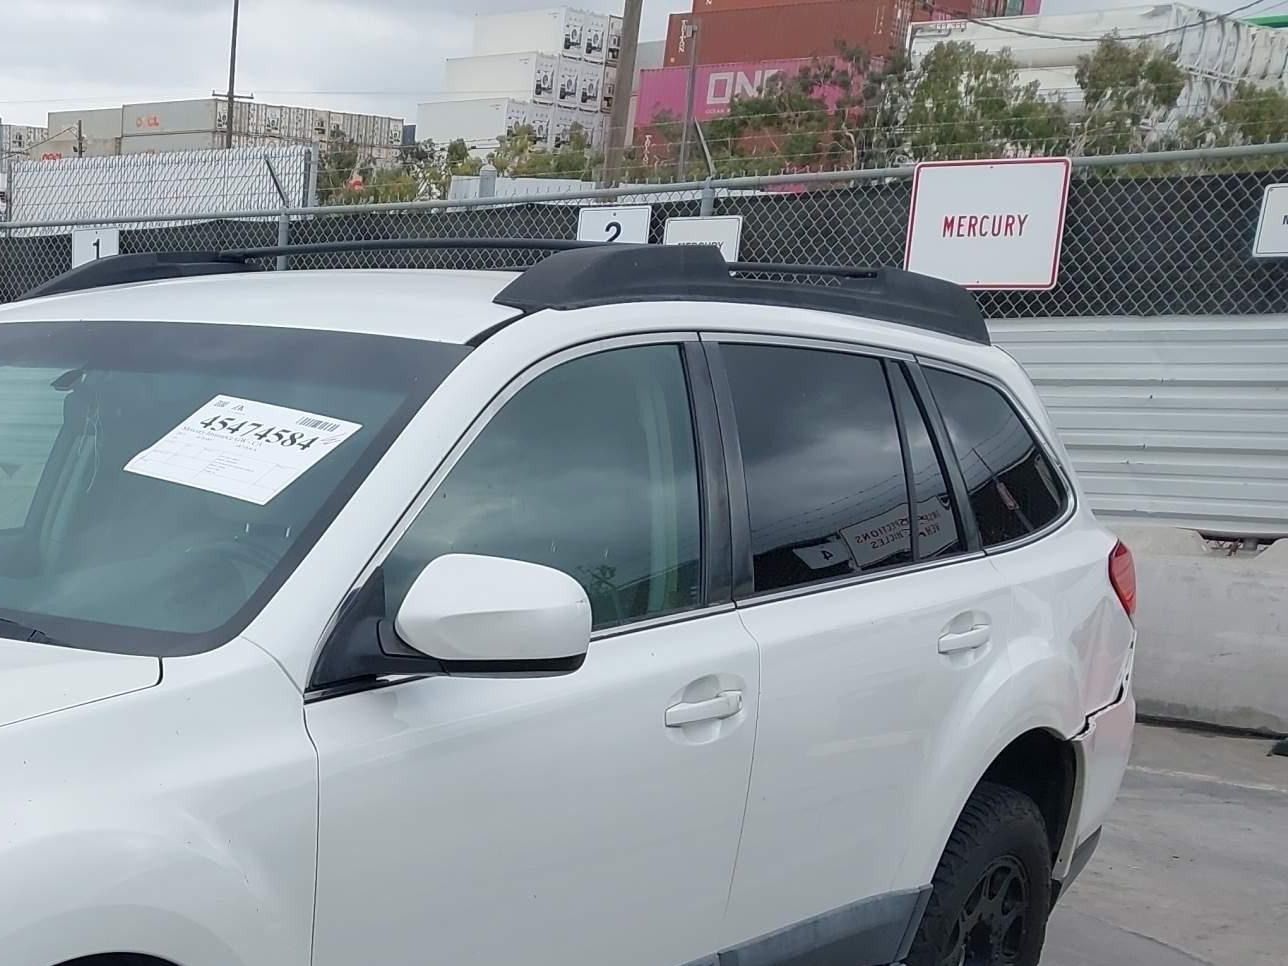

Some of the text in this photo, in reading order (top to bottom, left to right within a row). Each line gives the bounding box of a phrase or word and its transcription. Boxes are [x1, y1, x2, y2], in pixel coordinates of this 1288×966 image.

[135, 116, 160, 127] OCL
[605, 221, 622, 243] 2
[942, 214, 1029, 238] MERCURY
[92, 238, 100, 260] 1
[200, 415, 320, 451] 45474584
